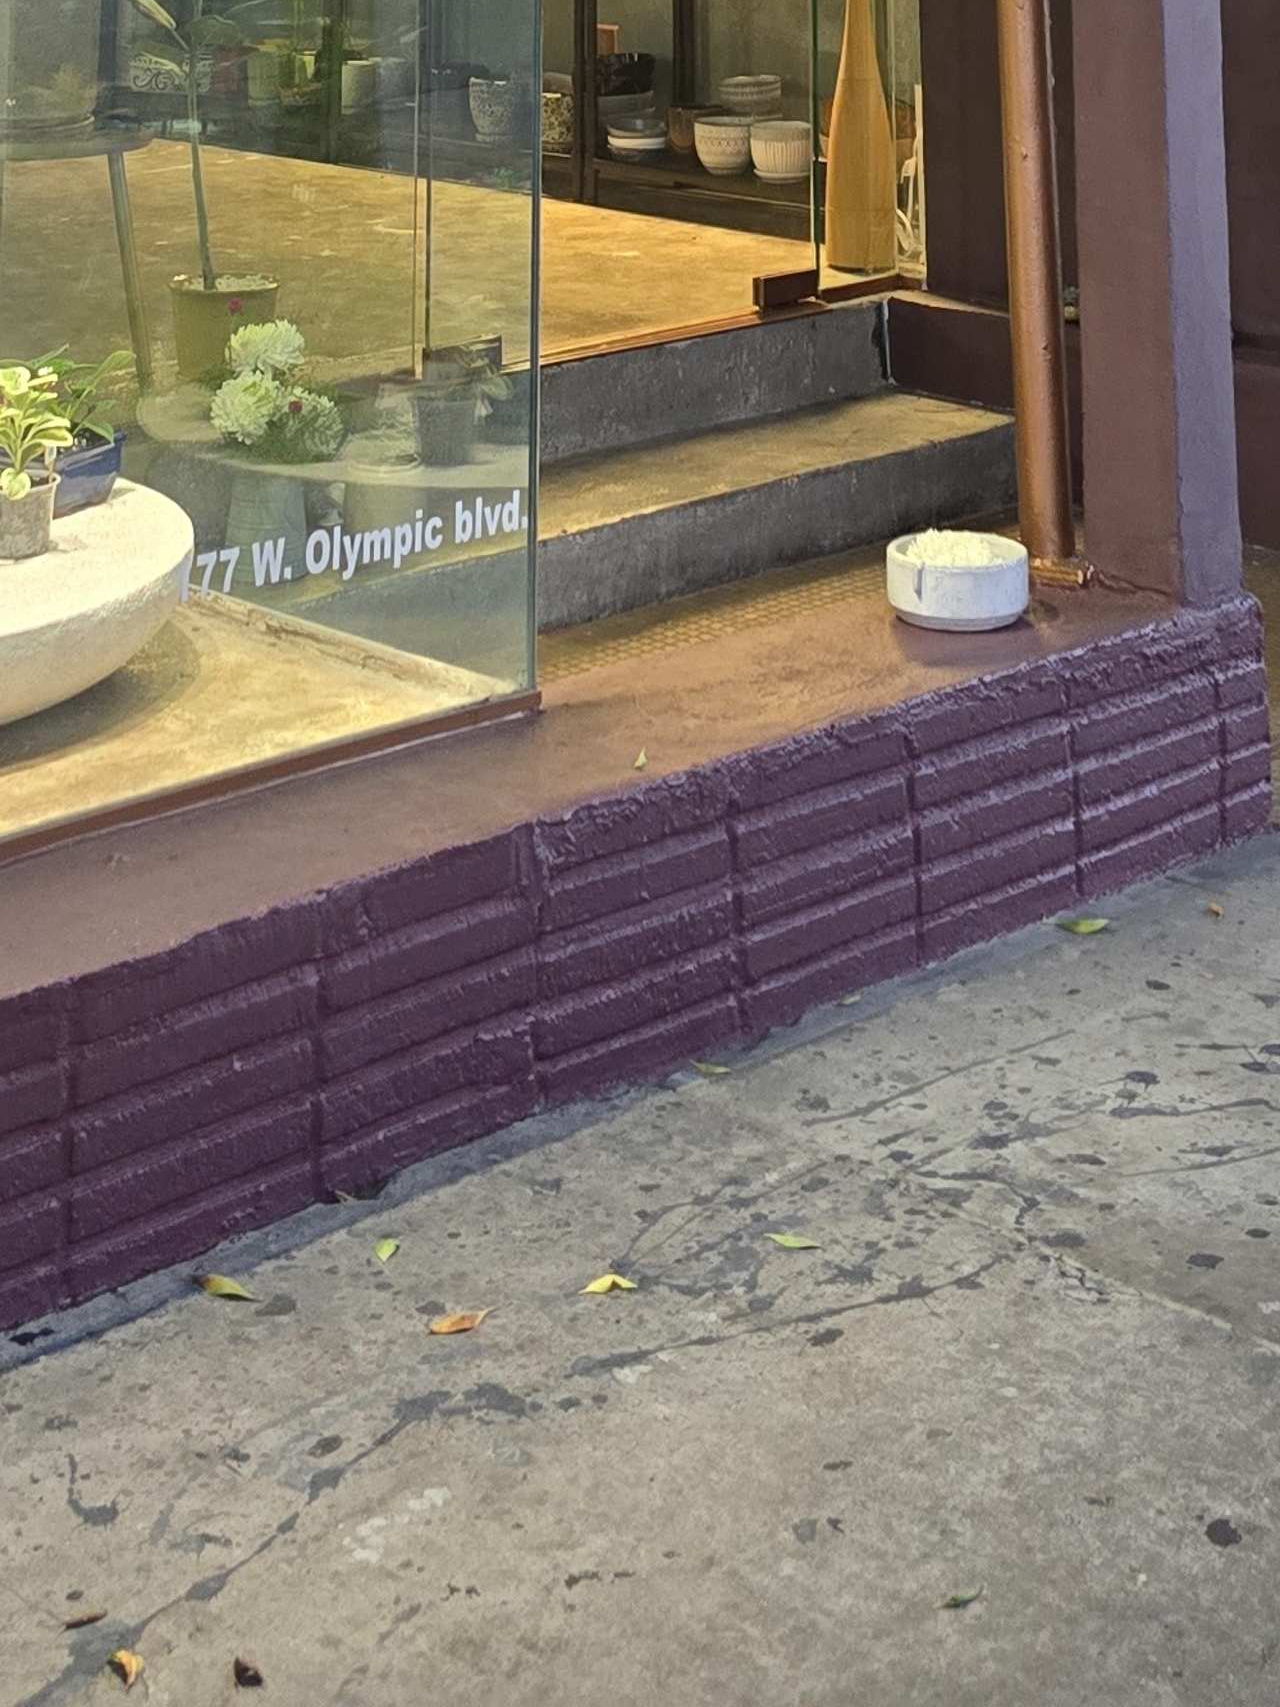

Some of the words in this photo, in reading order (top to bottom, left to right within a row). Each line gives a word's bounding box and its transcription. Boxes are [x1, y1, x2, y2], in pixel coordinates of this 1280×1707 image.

[179, 546, 240, 603] 177
[252, 536, 292, 587] W.
[305, 509, 444, 581] Olympic
[455, 489, 528, 544] blvd.
